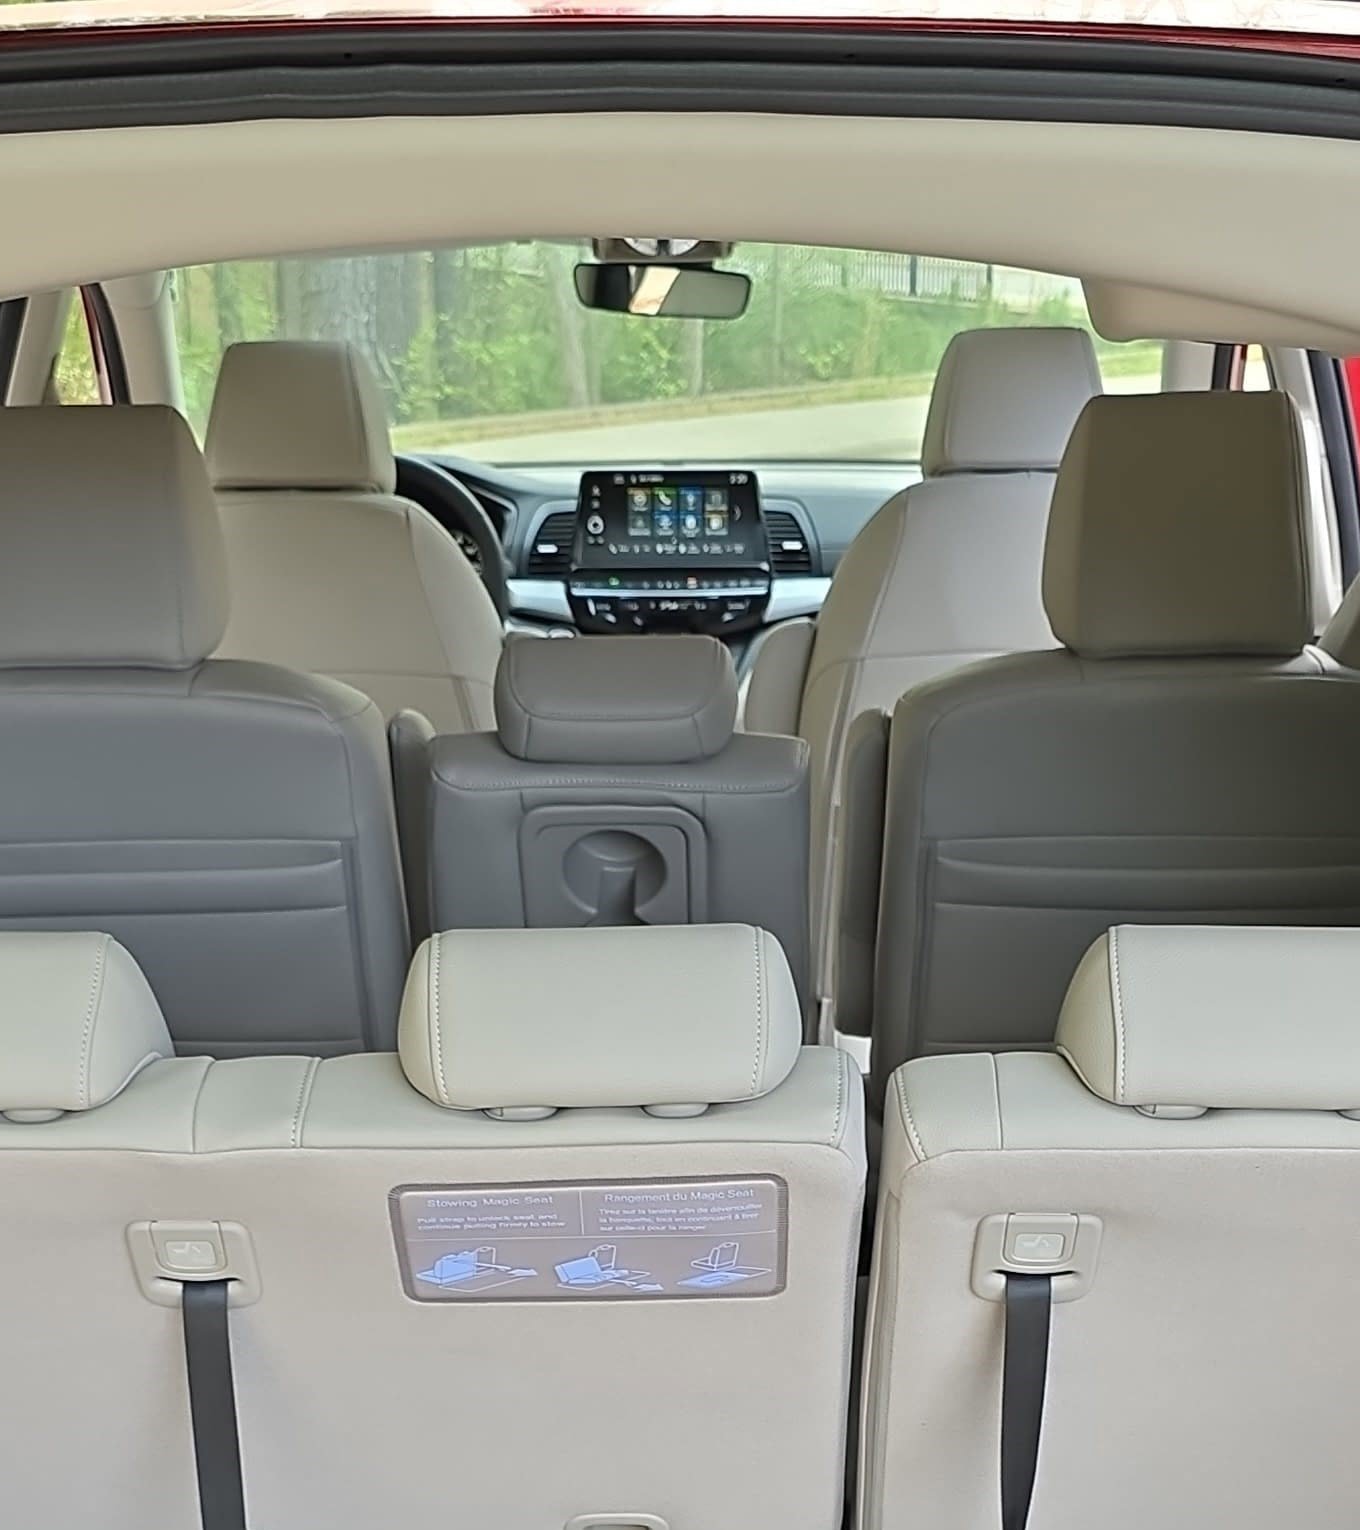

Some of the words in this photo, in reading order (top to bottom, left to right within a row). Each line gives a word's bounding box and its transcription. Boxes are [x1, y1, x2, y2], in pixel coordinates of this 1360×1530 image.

[427, 1199, 478, 1208] Stowing
[483, 1198, 520, 1208] Magic
[525, 1196, 554, 1205] Seat
[604, 1193, 670, 1203] Rangement
[672, 1191, 688, 1201] du
[690, 1190, 725, 1202] Magic
[727, 1188, 755, 1198] Seat
